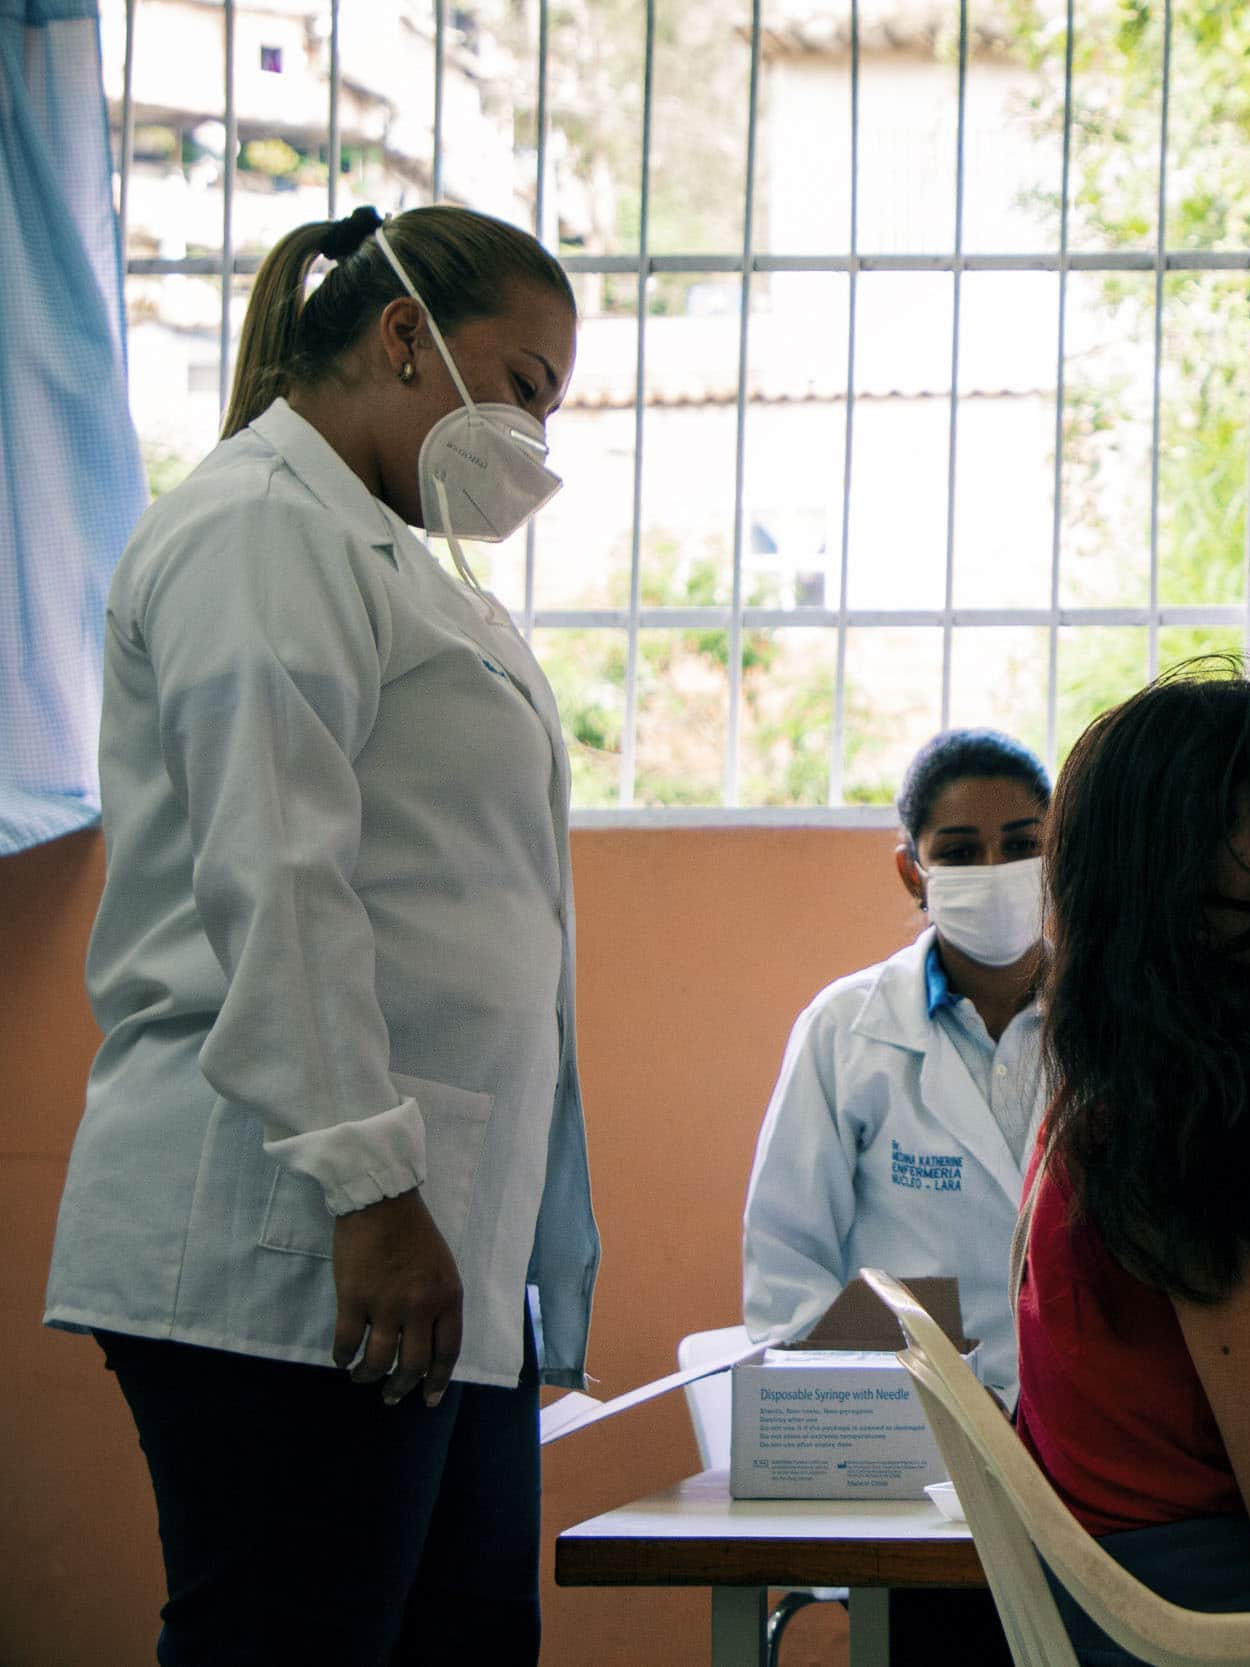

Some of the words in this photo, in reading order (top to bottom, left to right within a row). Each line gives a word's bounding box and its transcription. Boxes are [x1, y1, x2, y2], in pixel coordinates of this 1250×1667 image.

[919, 1155, 963, 1167] KATHERINE
[892, 1162, 962, 1179] ENFERMERIA
[935, 1180, 962, 1191] LARA
[760, 1388, 813, 1403] Disposable
[814, 1389, 851, 1403] Syringe
[852, 1388, 874, 1400] with
[876, 1388, 910, 1400] Needle
